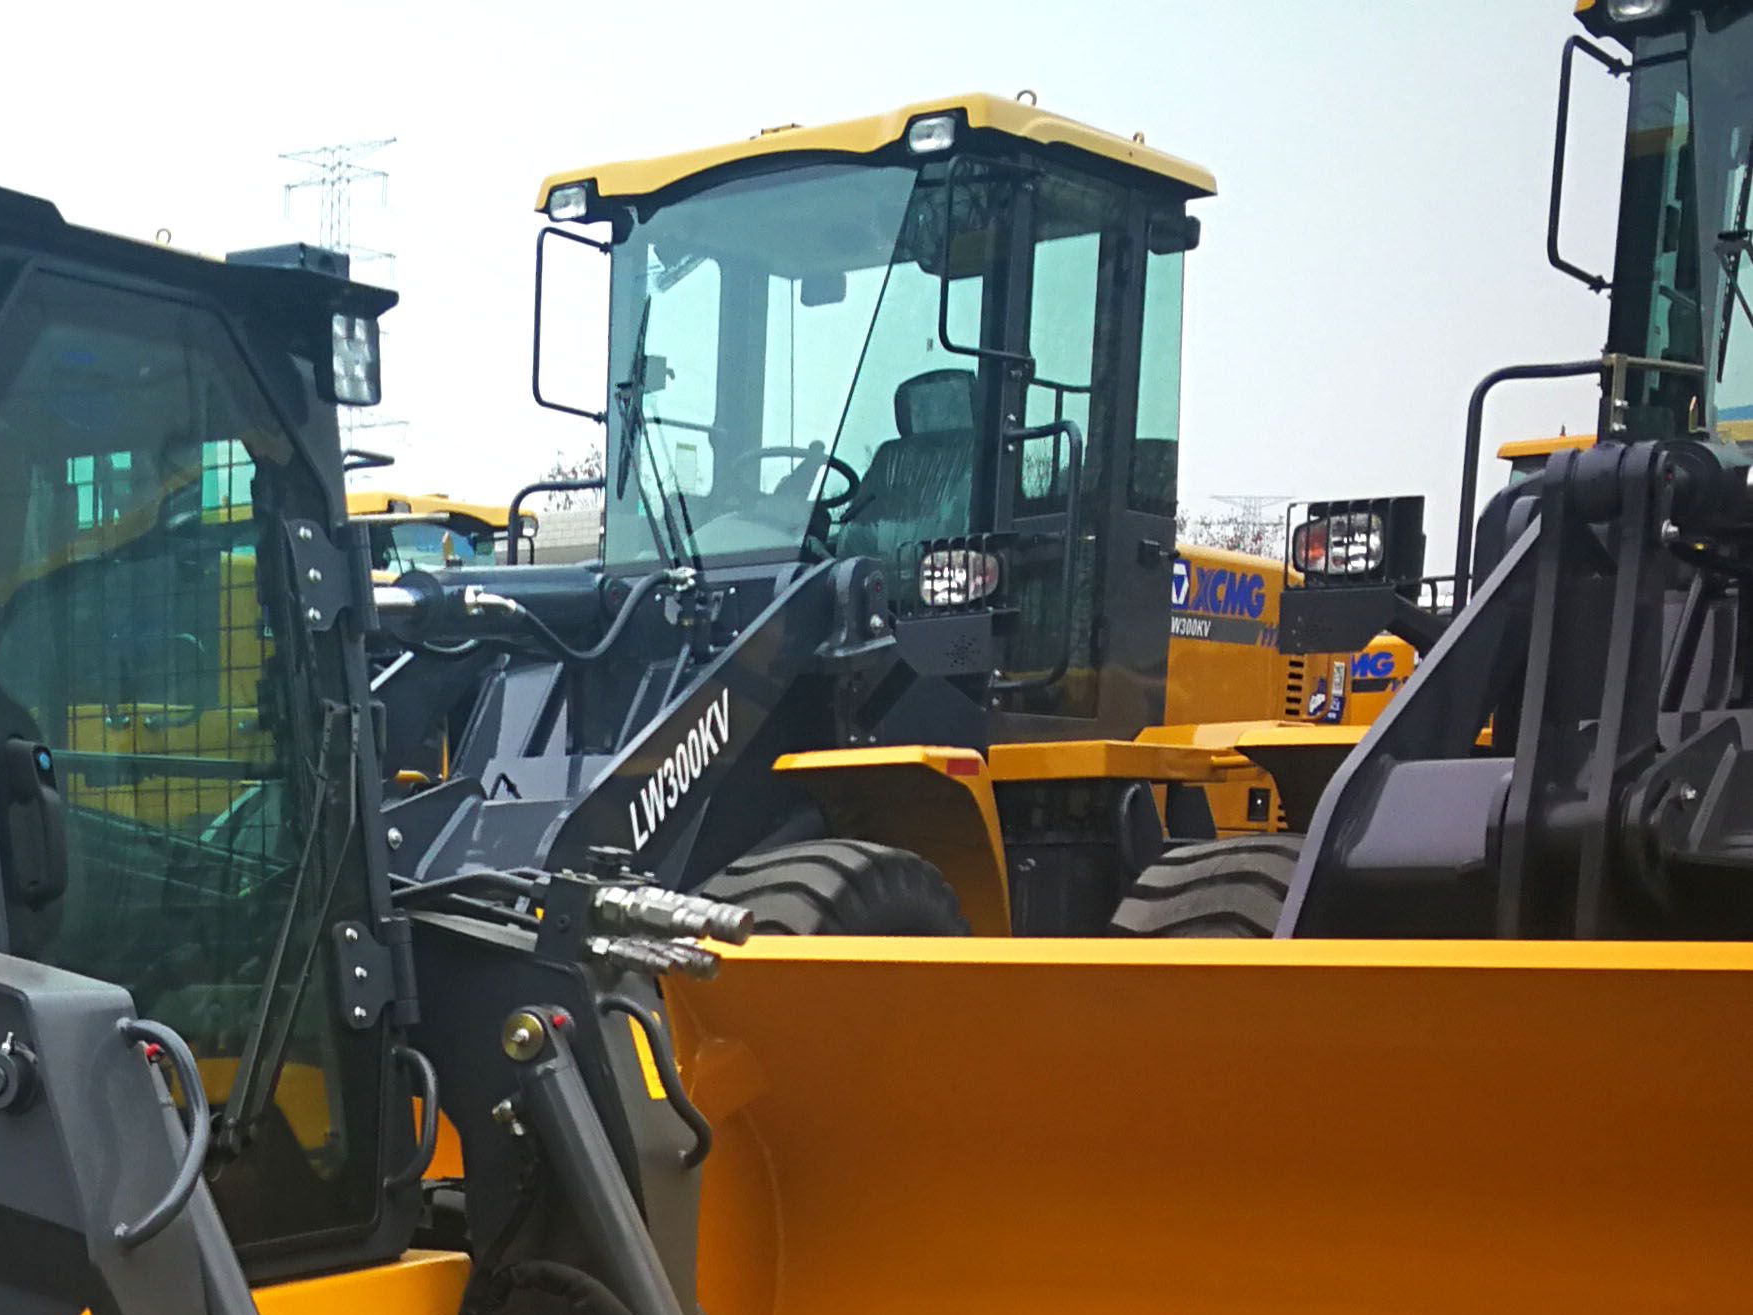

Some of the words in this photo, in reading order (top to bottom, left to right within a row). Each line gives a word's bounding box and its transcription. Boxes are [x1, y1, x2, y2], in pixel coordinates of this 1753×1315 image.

[1191, 567, 1265, 618] XCMG
[1171, 616, 1211, 637] W300KV
[1350, 651, 1395, 677] MG
[629, 687, 729, 851] LW300KV
